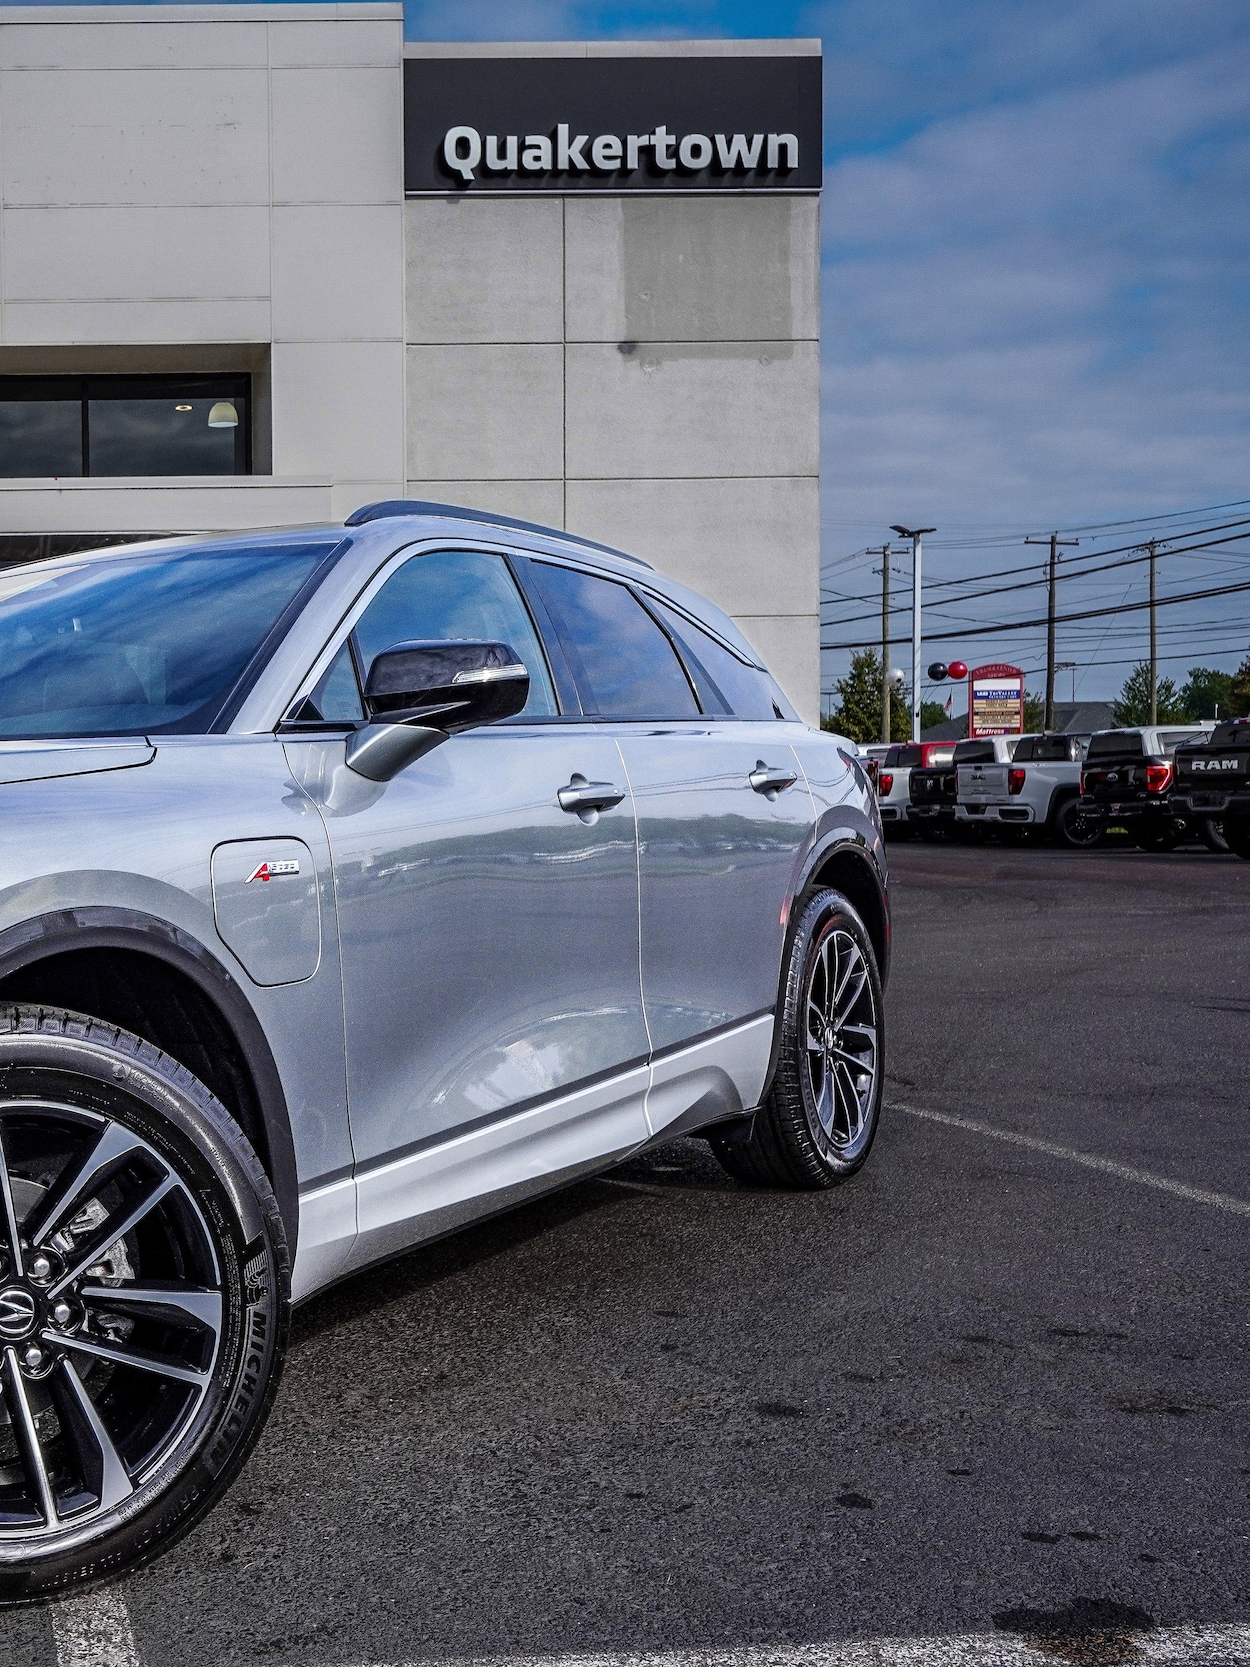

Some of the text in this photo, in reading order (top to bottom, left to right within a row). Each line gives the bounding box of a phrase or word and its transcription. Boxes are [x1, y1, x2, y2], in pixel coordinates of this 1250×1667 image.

[443, 123, 800, 181] Quakertown
[976, 727, 1005, 735] Mattress
[1191, 759, 1239, 771] RAM
[209, 1310, 267, 1467] MICHELIN
